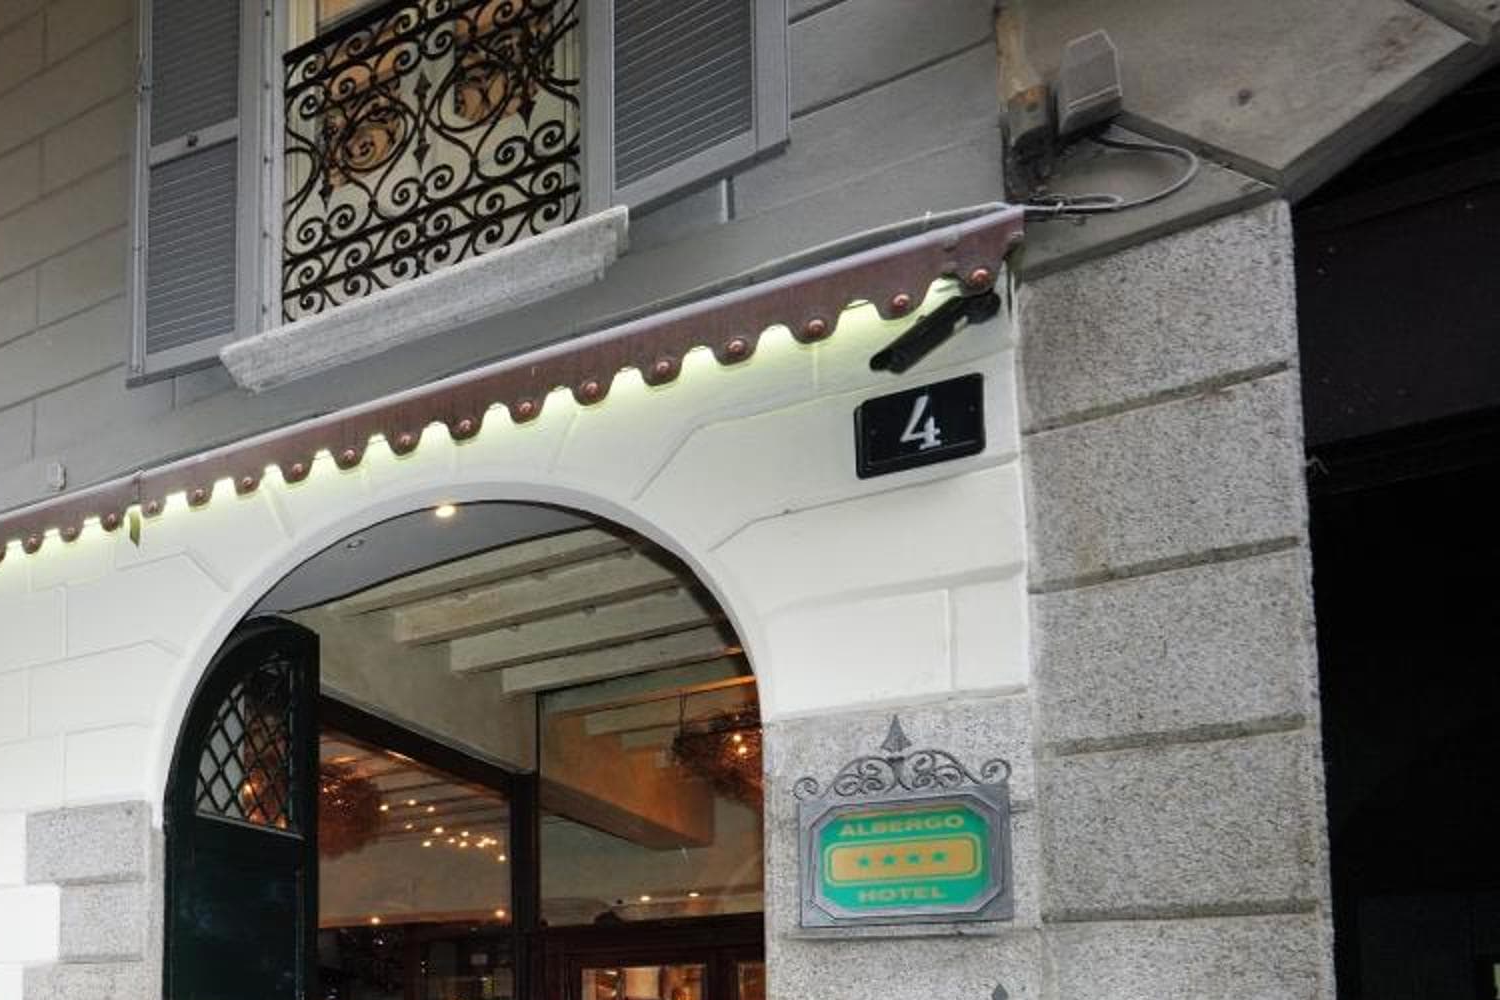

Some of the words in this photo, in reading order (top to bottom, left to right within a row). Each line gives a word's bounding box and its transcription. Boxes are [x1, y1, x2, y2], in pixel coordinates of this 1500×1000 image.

[900, 395, 942, 450] 4
[839, 814, 966, 837] ALBERGO
[857, 886, 944, 902] HOTEL
